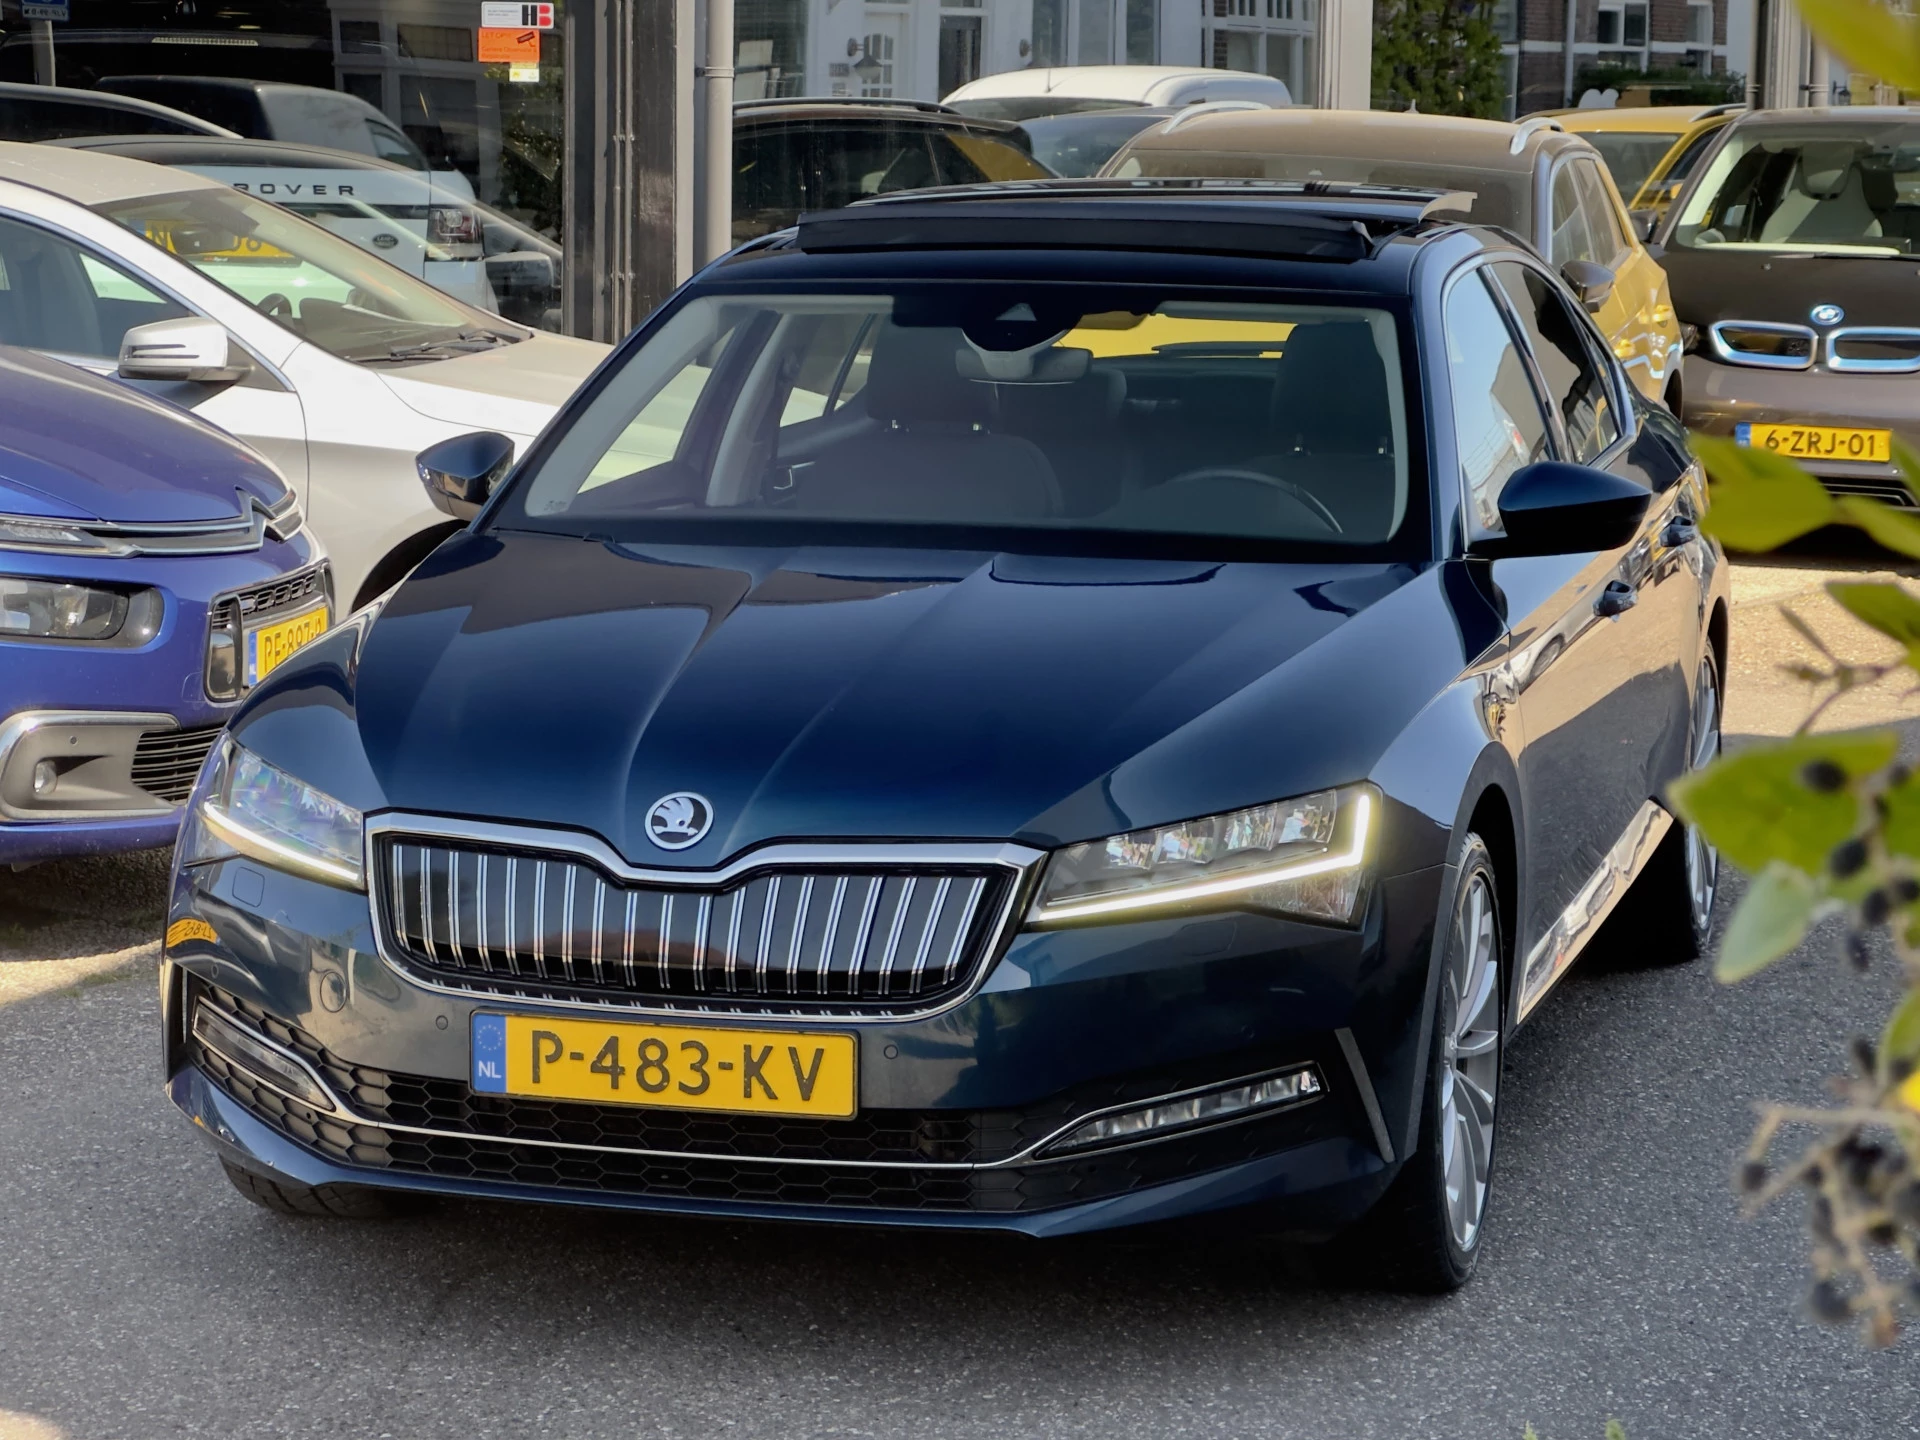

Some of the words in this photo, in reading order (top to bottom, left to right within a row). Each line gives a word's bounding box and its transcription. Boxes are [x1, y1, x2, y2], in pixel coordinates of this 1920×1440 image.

[521, 4, 552, 27] HB
[1765, 429, 1875, 457] 6-ZRJ-01
[478, 1061, 502, 1079] NL
[531, 1030, 825, 1102] P-483-KV
